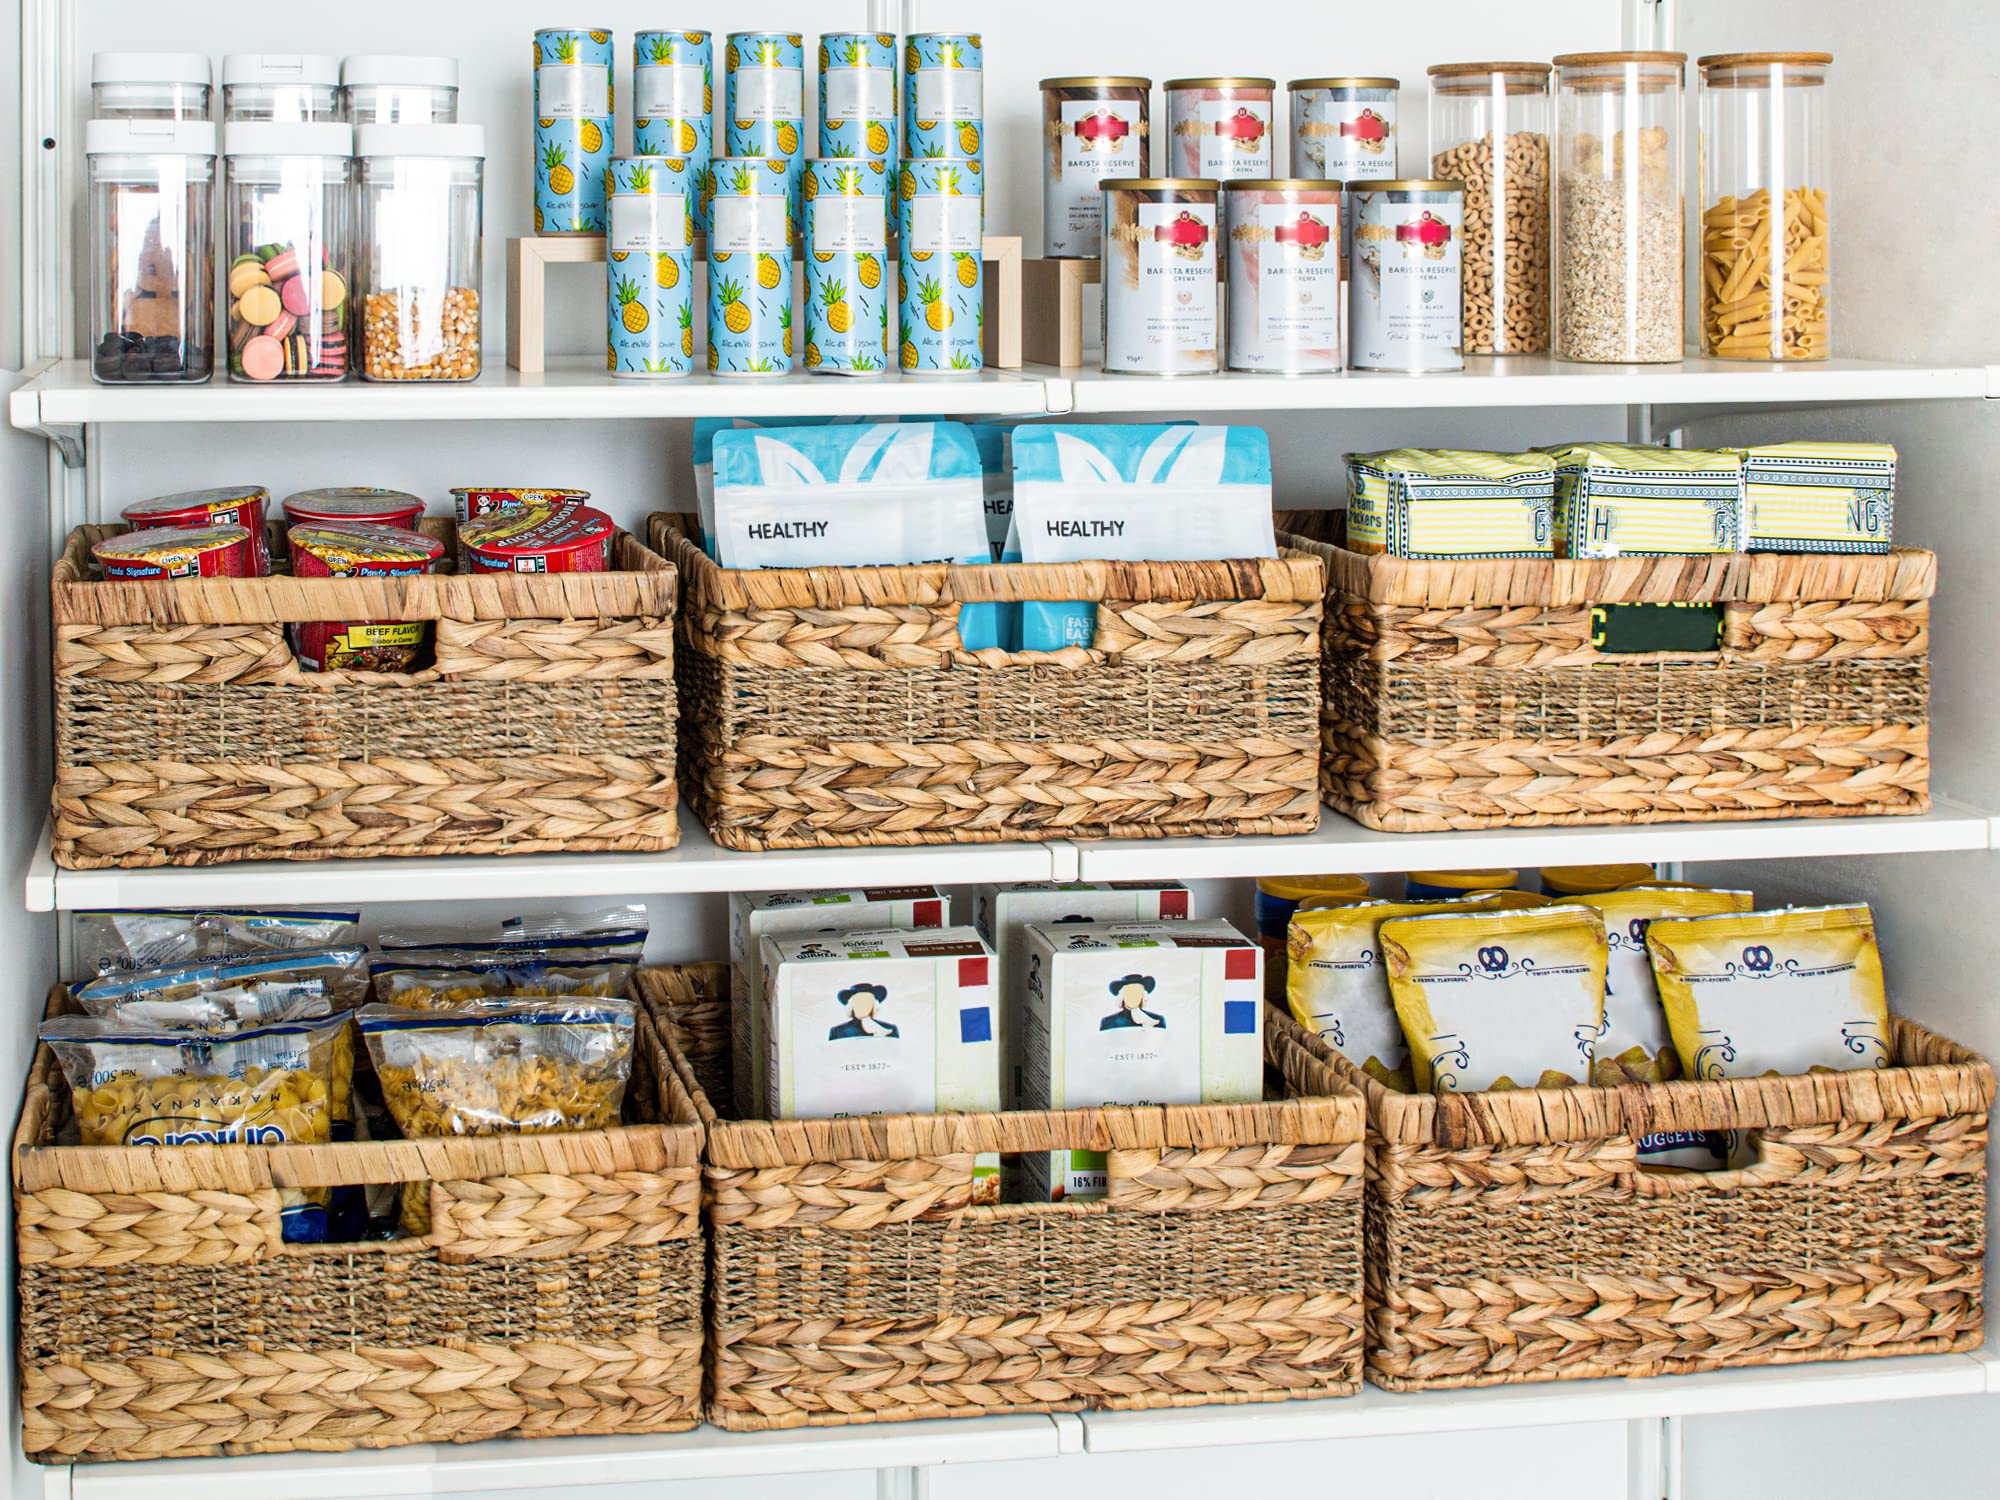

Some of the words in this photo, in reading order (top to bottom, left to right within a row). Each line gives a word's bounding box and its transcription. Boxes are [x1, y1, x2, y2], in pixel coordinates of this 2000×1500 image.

[534, 505, 578, 534] NOODLE
[542, 520, 580, 539] RAMEN
[748, 521, 829, 540] HEALTHY
[1046, 520, 1125, 537] HEALTHY
[496, 531, 537, 547] SOUP
[161, 555, 184, 565] OPEN
[327, 556, 347, 565] OPEN
[126, 566, 162, 577] Signature
[360, 567, 387, 577] Panda
[1068, 617, 1095, 628] FAST
[366, 627, 391, 636] BEEF
[392, 625, 420, 635] FLAVOR
[796, 952, 838, 960] QUAKER
[121, 1069, 136, 1077] Net
[171, 1068, 187, 1076] Net
[122, 1092, 281, 1114] MAKARNASI
[1637, 1130, 1706, 1148] UGGETS
[1073, 1177, 1091, 1187] 16%
